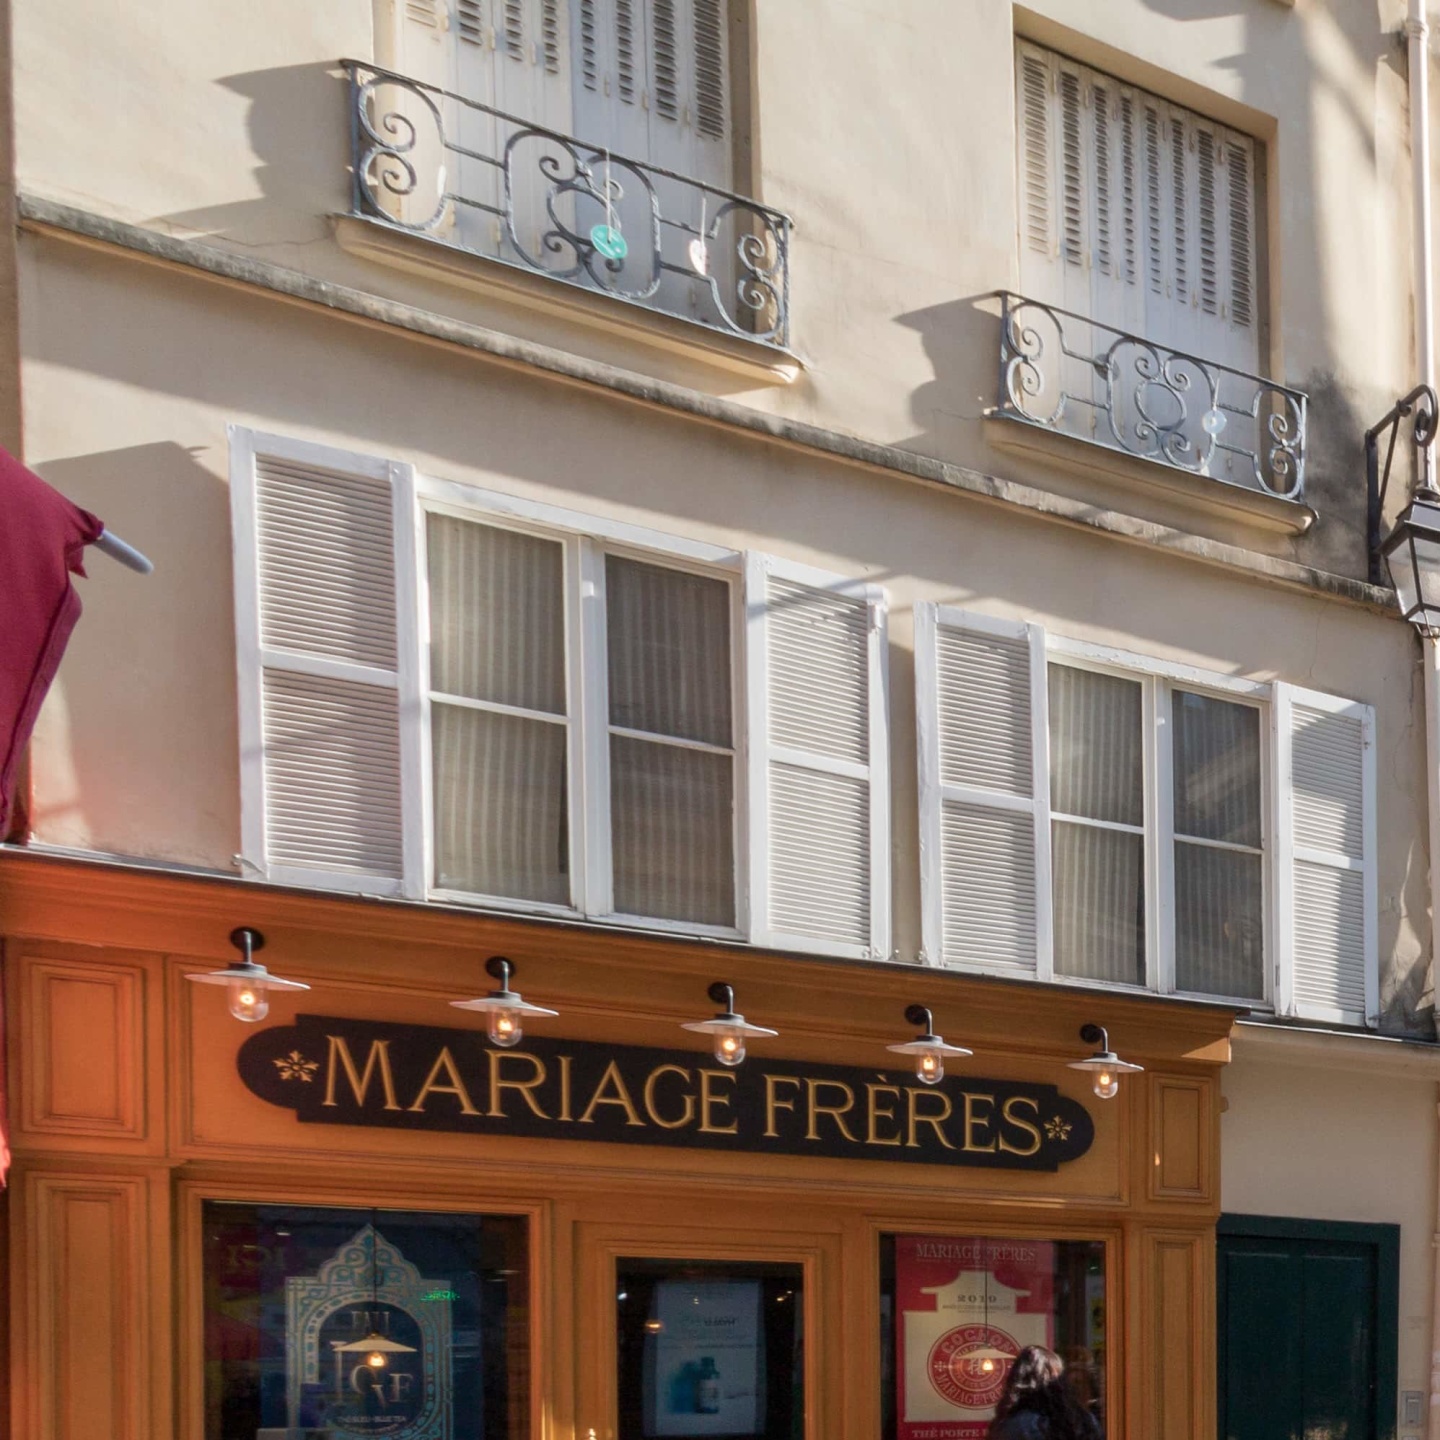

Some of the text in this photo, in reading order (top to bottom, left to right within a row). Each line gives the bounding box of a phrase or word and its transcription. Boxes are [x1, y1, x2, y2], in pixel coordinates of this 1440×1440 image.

[322, 1035, 1041, 1157] MARIAGE FRÈRES
[916, 1242, 981, 1260] MARIAGE
[940, 1329, 1016, 1354] COCHON
[940, 1428, 980, 1438] PORTE
